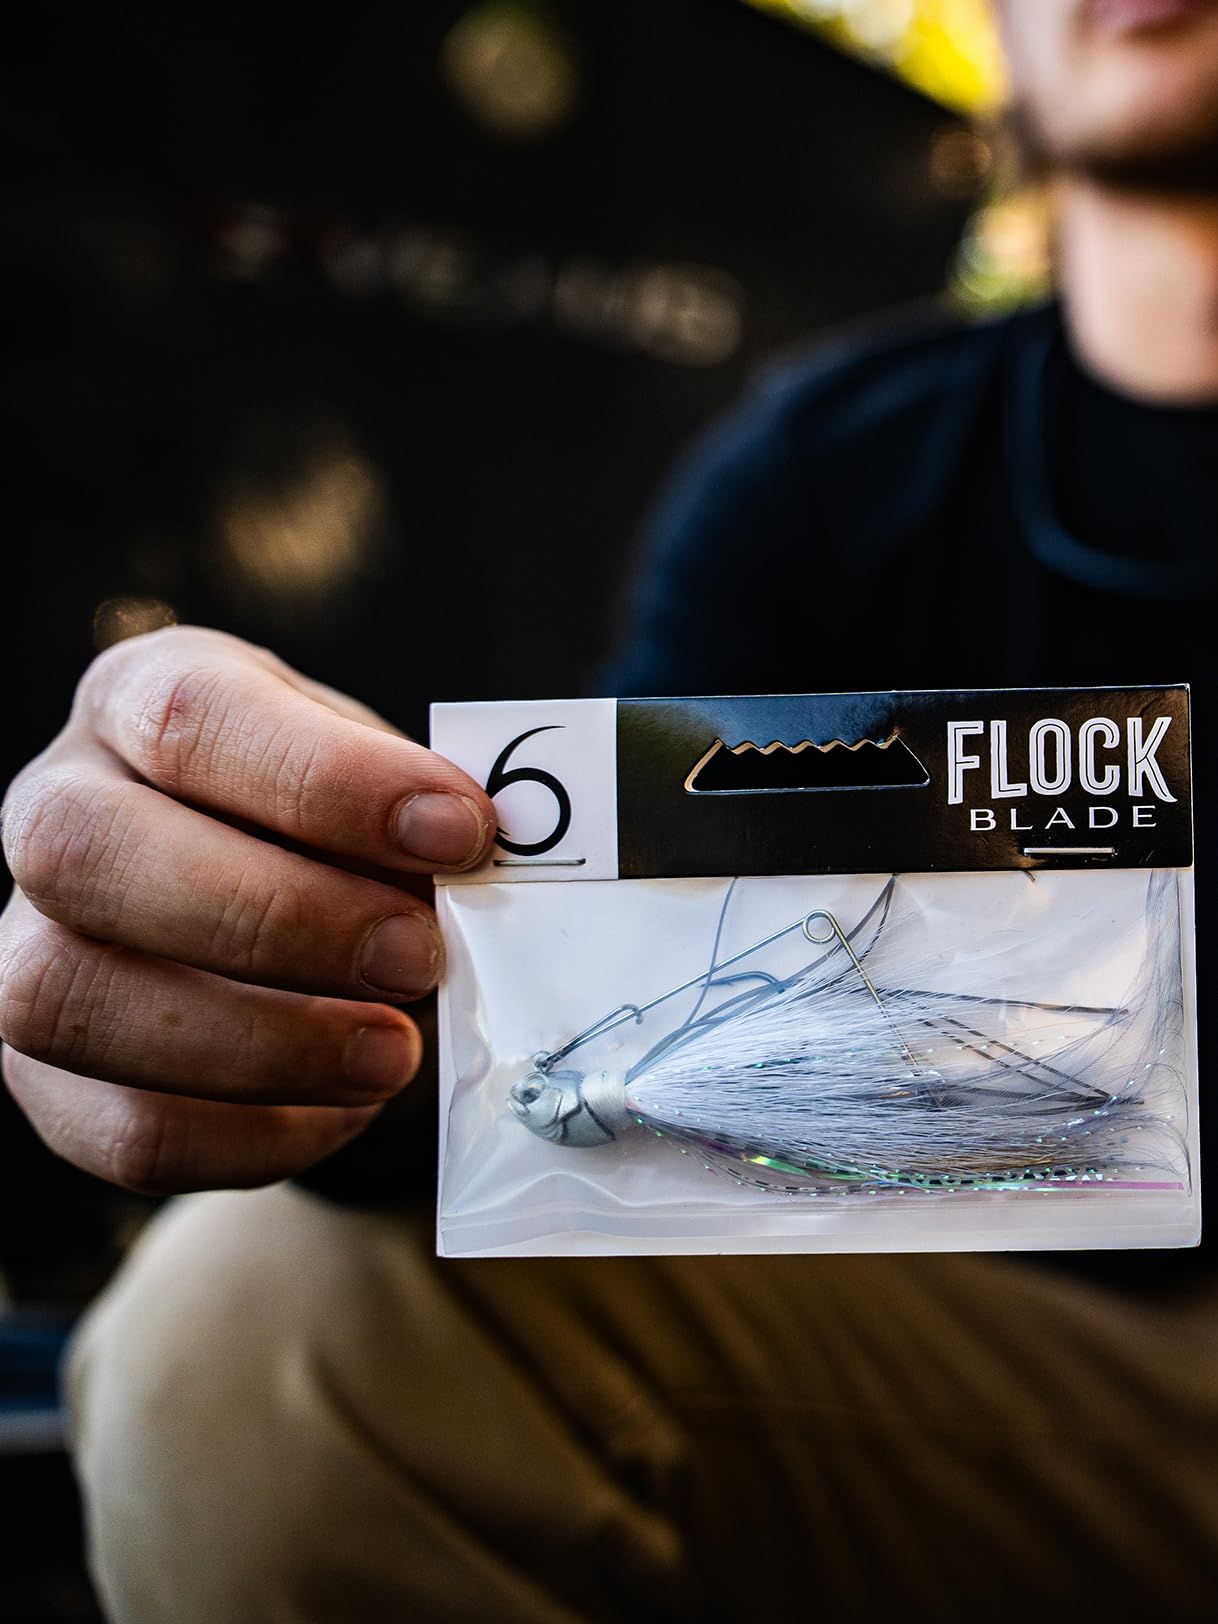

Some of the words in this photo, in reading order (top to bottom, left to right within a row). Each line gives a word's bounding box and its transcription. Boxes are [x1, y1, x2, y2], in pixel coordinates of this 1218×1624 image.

[485, 725, 572, 857] 6
[947, 716, 1178, 805] FLOCK
[969, 805, 1157, 831] BLADE
